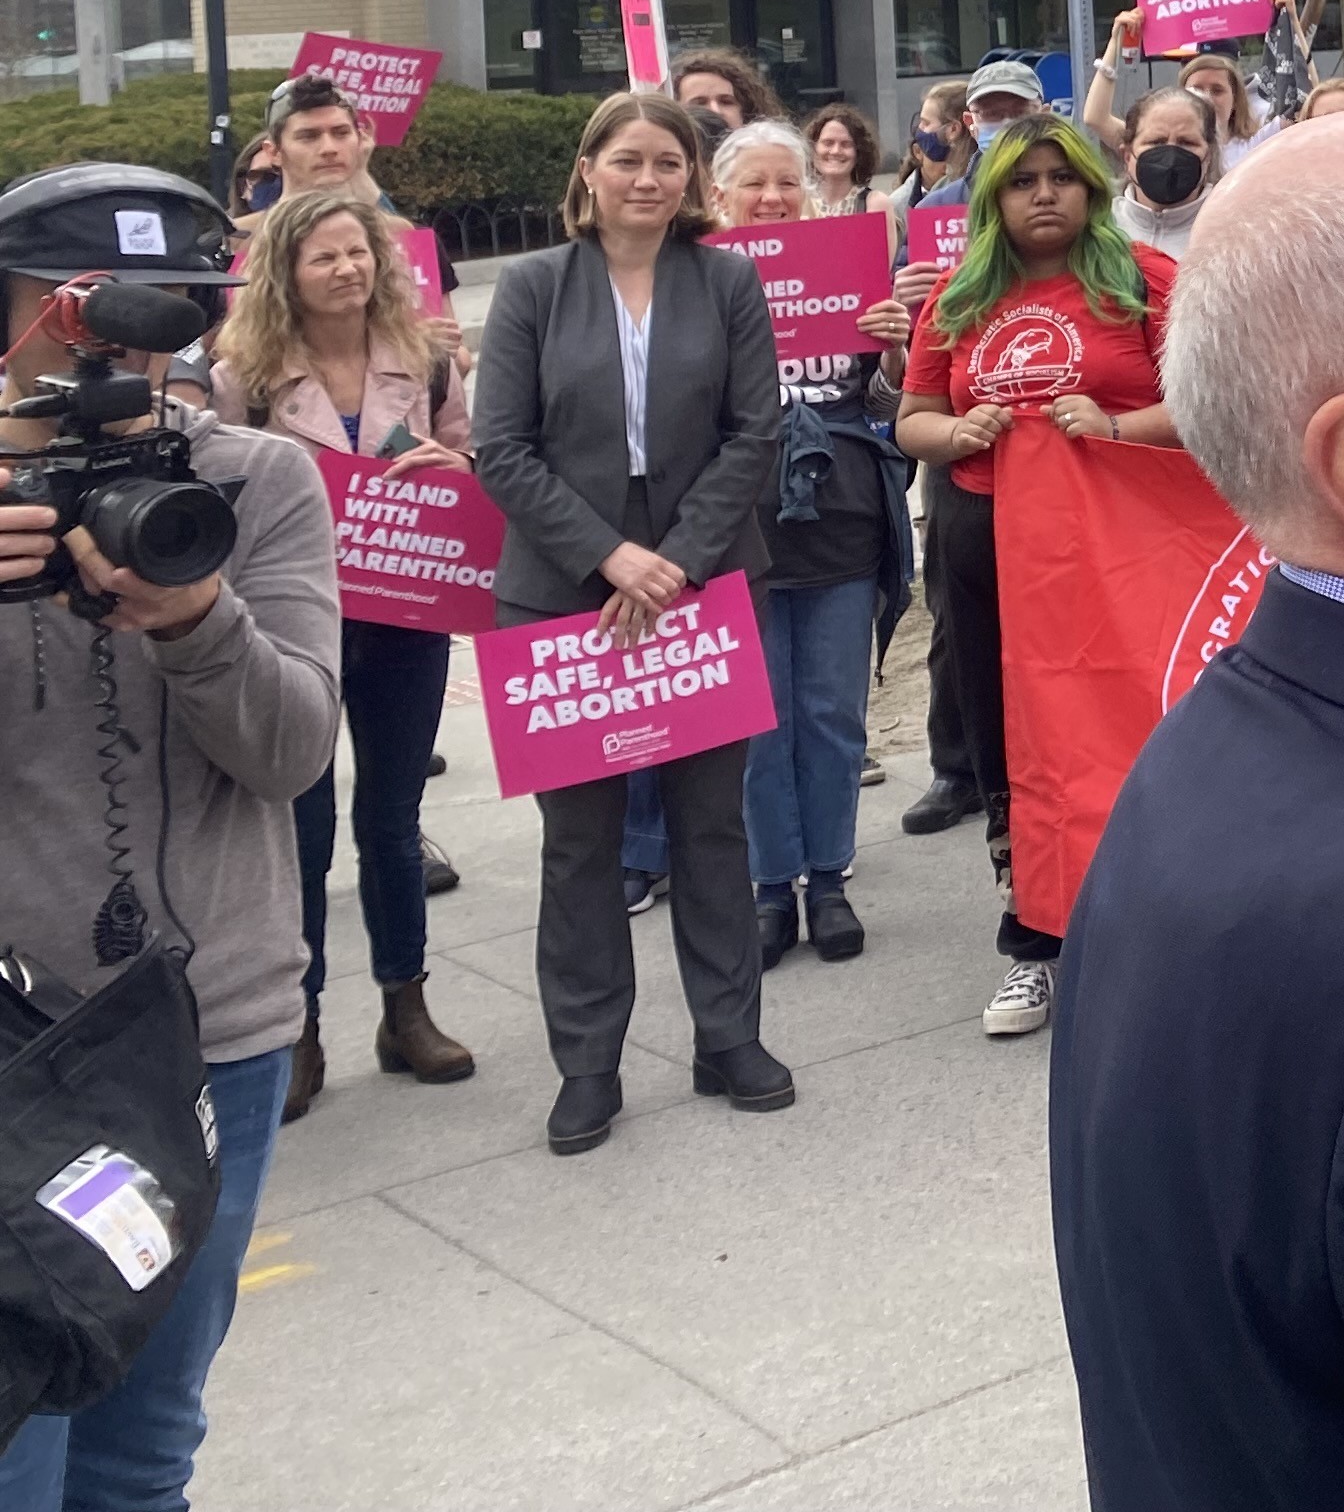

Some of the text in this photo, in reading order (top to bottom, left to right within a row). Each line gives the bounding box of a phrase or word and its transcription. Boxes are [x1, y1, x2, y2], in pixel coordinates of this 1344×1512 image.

[330, 47, 421, 75] PROTECT
[372, 75, 423, 95] LEGAL
[967, 304, 1085, 374] Democratic Socialists of America
[347, 473, 460, 508] I STAND
[345, 498, 419, 529] WITH
[336, 522, 465, 559] PLANNED
[504, 626, 740, 706] SAFE, LEGAL
[526, 659, 730, 734] ABORTION
